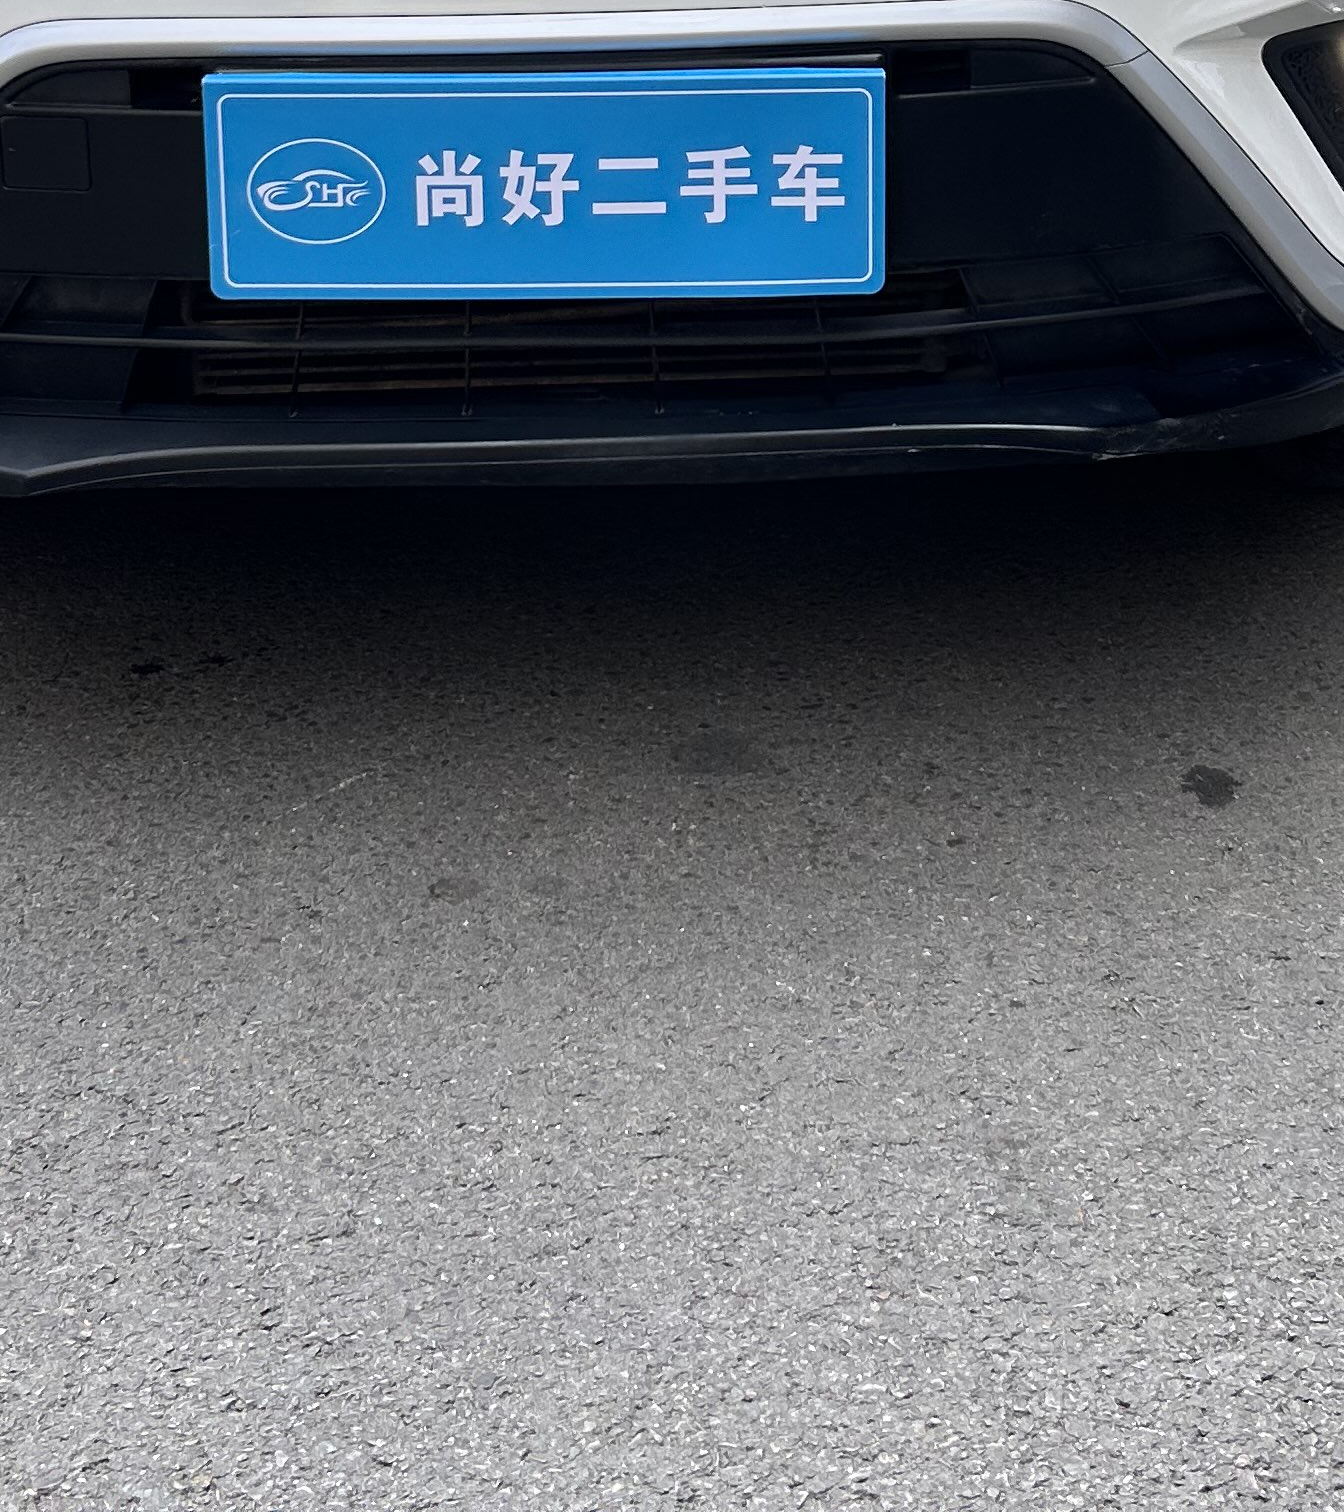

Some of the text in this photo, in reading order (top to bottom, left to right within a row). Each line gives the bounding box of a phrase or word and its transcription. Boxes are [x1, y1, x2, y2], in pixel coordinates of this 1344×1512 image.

[414, 144, 846, 227] 尚好二手车
